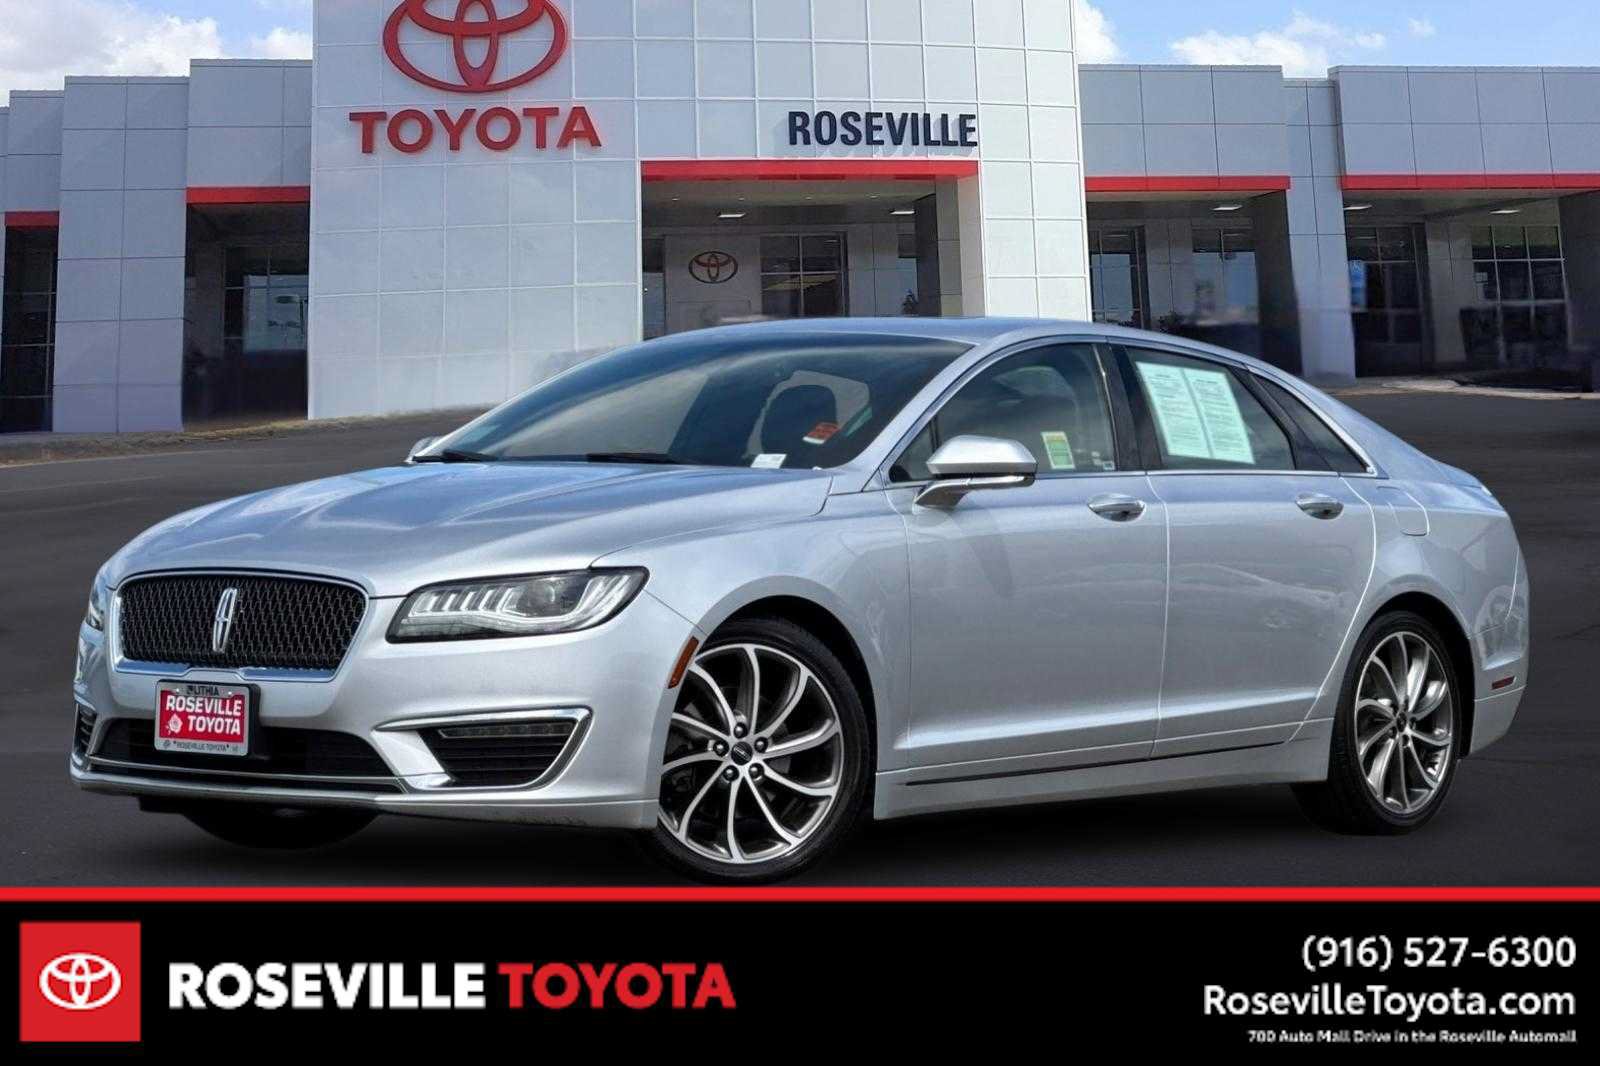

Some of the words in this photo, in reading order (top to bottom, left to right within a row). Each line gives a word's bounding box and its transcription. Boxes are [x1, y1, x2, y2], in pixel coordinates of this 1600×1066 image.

[349, 106, 602, 154] TOYOTA
[788, 110, 979, 147] ROSEVILLE
[166, 695, 242, 716] ROSEVILLE
[187, 715, 241, 735] TOYOTA
